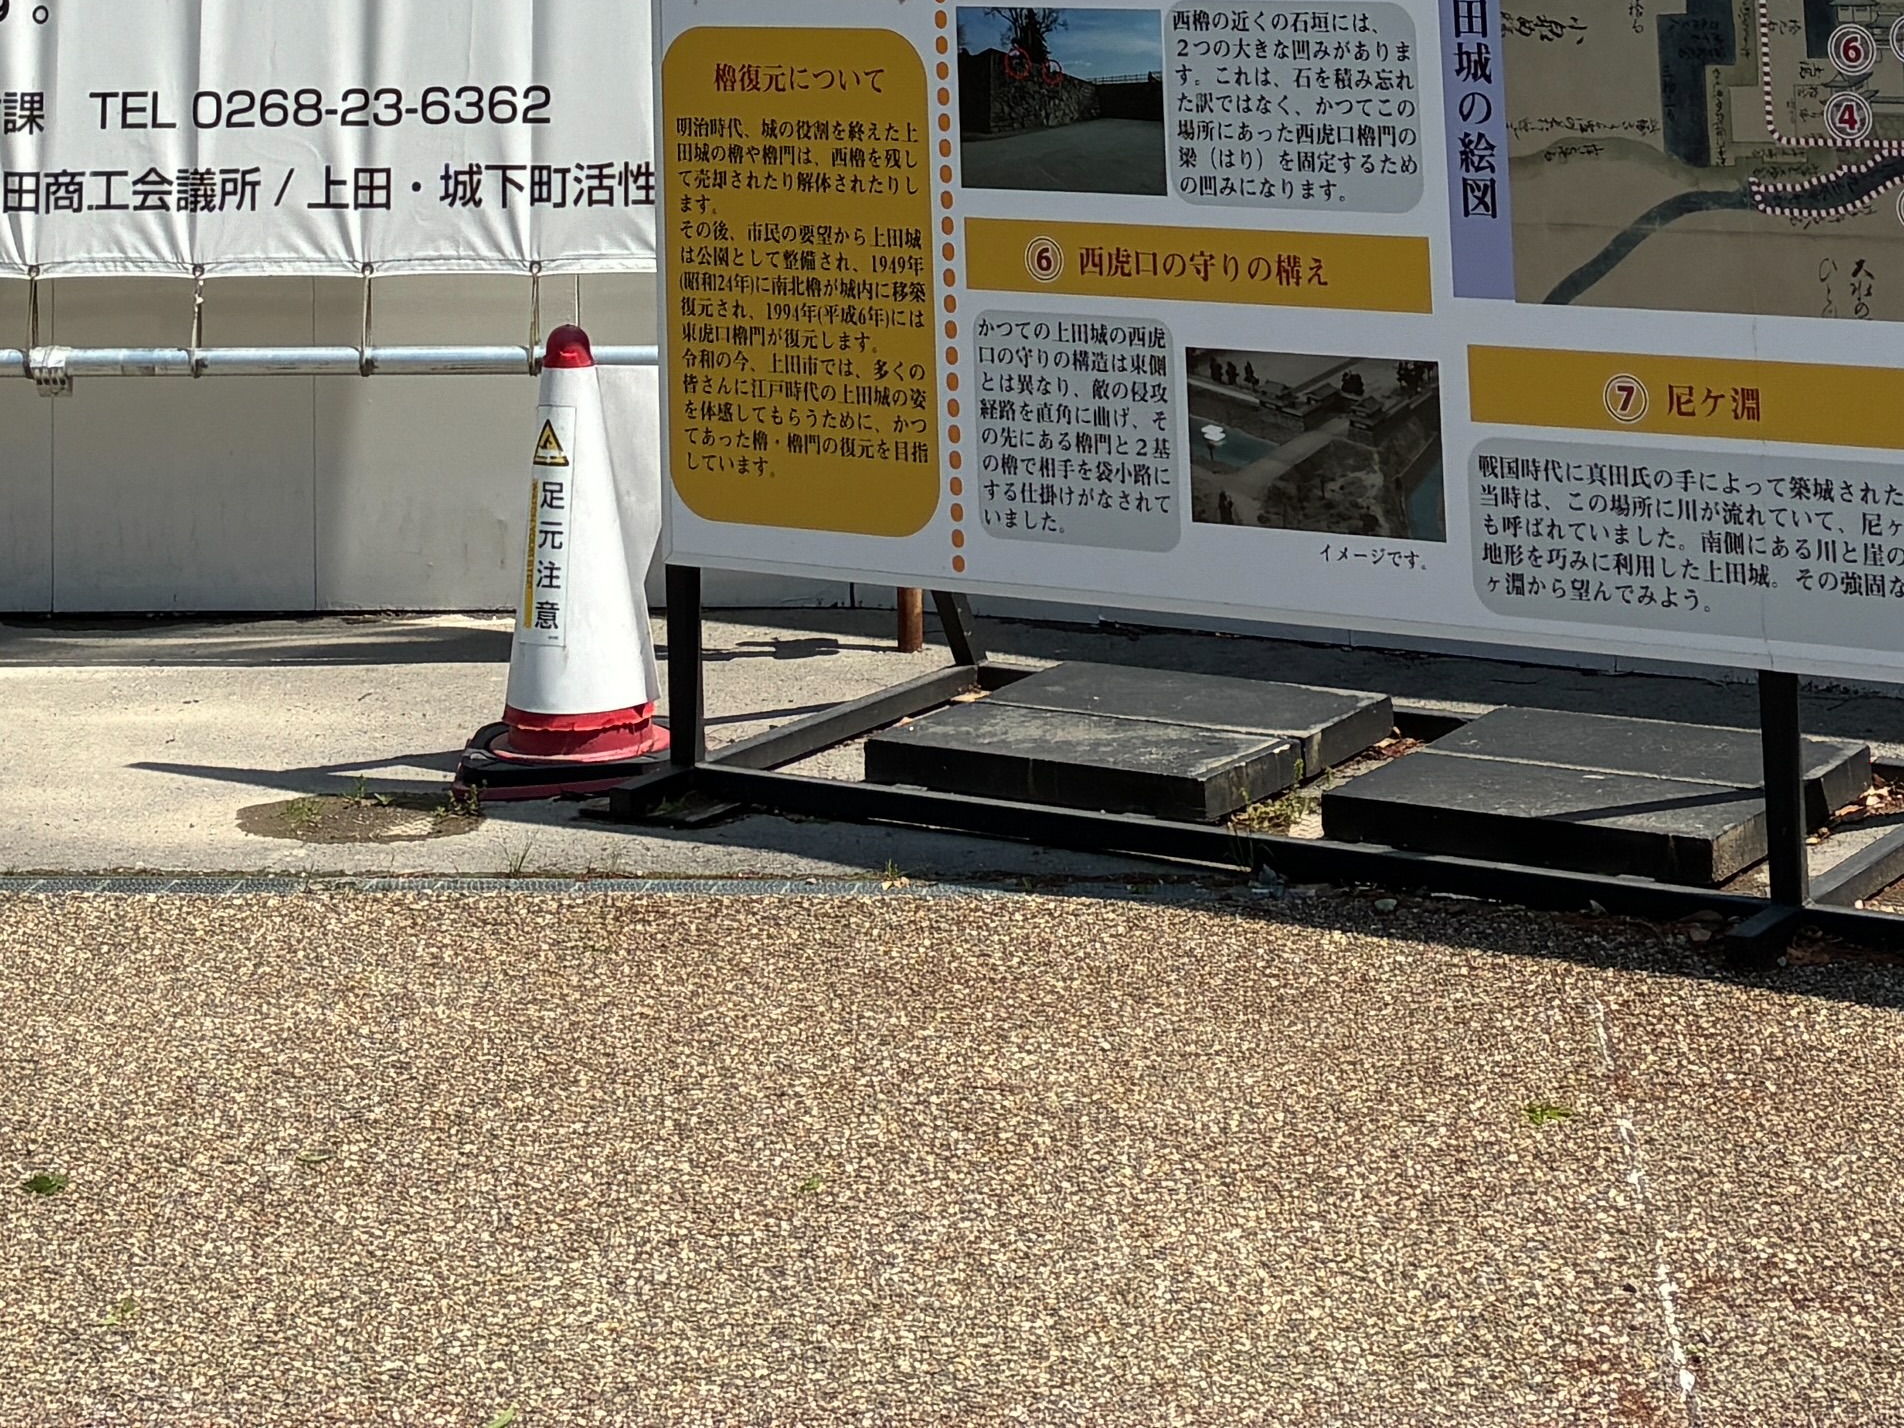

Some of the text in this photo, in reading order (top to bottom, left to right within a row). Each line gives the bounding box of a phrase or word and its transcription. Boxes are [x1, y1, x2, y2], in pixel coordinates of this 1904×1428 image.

[1173, 9, 1379, 34] 西櫓の近くの石垣には、
[714, 64, 885, 93] 櫓復元について
[1175, 65, 1414, 91] す。これは、石を積み忘れ
[90, 92, 175, 130] TEL
[193, 86, 552, 129] 0268-23-6362
[1176, 92, 1415, 118] た訳ではなく、かつてこの
[677, 118, 918, 143] 明治時代、城の役割を終えた上
[1177, 121, 1416, 147] 場所にあった西虎口櫓門の
[677, 142, 917, 169] 田城の櫓や櫓門は、西櫓を残し
[678, 169, 918, 194] て売却されたり解体されたりし
[1180, 175, 1347, 203] の凹みになります。
[681, 194, 717, 215] ます。
[680, 221, 922, 250] その後、市民の要望から上田城
[1079, 246, 1329, 287] 西虎口の守りの構え
[682, 322, 877, 354] 東虎口櫓門が復元します。
[978, 318, 1166, 348] かつての上田城の西虎
[682, 348, 925, 381] 令和の今、上田市では、多くの
[979, 346, 1167, 376] 口の守りの構造は東側
[683, 374, 926, 410] 皆さんに江戸時代の上田城の姿
[685, 400, 927, 433] を体感してもらうために、かつ
[980, 399, 1168, 430] 経路を直角に曲げ、そ
[688, 452, 775, 478] しています。
[983, 455, 1170, 486] の櫓で相手を袋小路に
[983, 480, 1170, 513] する仕掛けがなされて
[985, 508, 1066, 534] いました。
[535, 482, 565, 629] 足元注意
[1320, 544, 1427, 571] イメージです。
